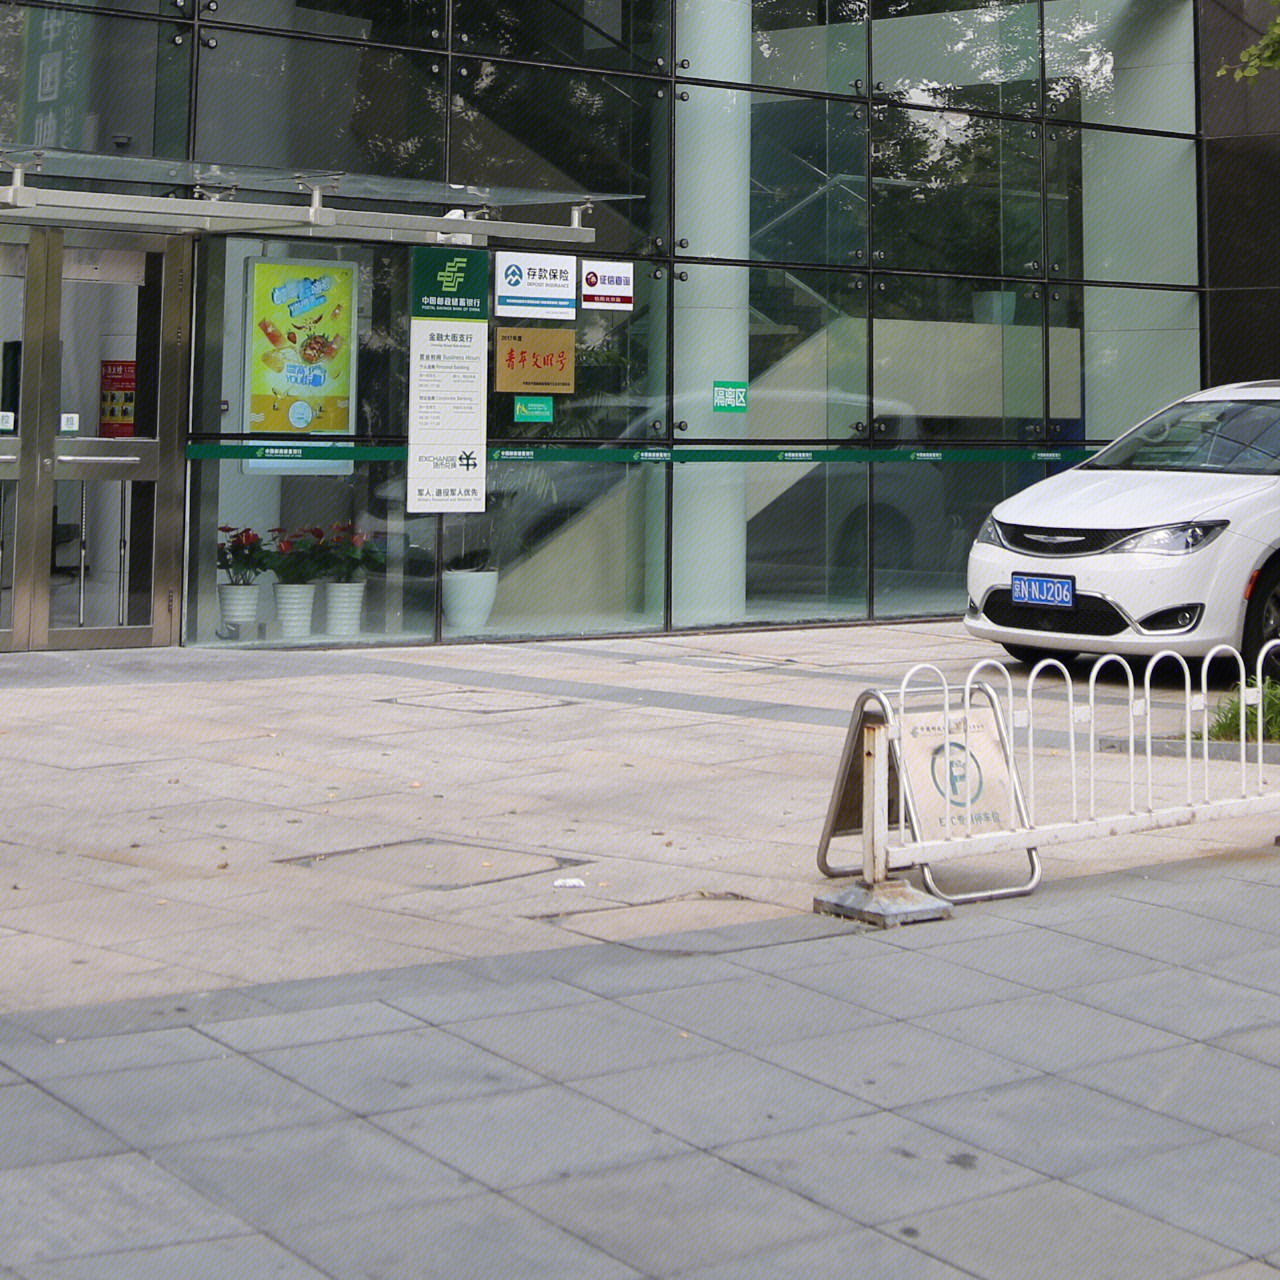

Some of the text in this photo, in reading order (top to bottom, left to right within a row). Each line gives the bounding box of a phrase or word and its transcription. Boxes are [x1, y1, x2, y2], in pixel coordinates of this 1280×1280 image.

[526, 267, 570, 282] 存款保险
[599, 274, 631, 287] 征信查询
[428, 332, 474, 343] 金融大街支行
[713, 387, 747, 408] 隔离区
